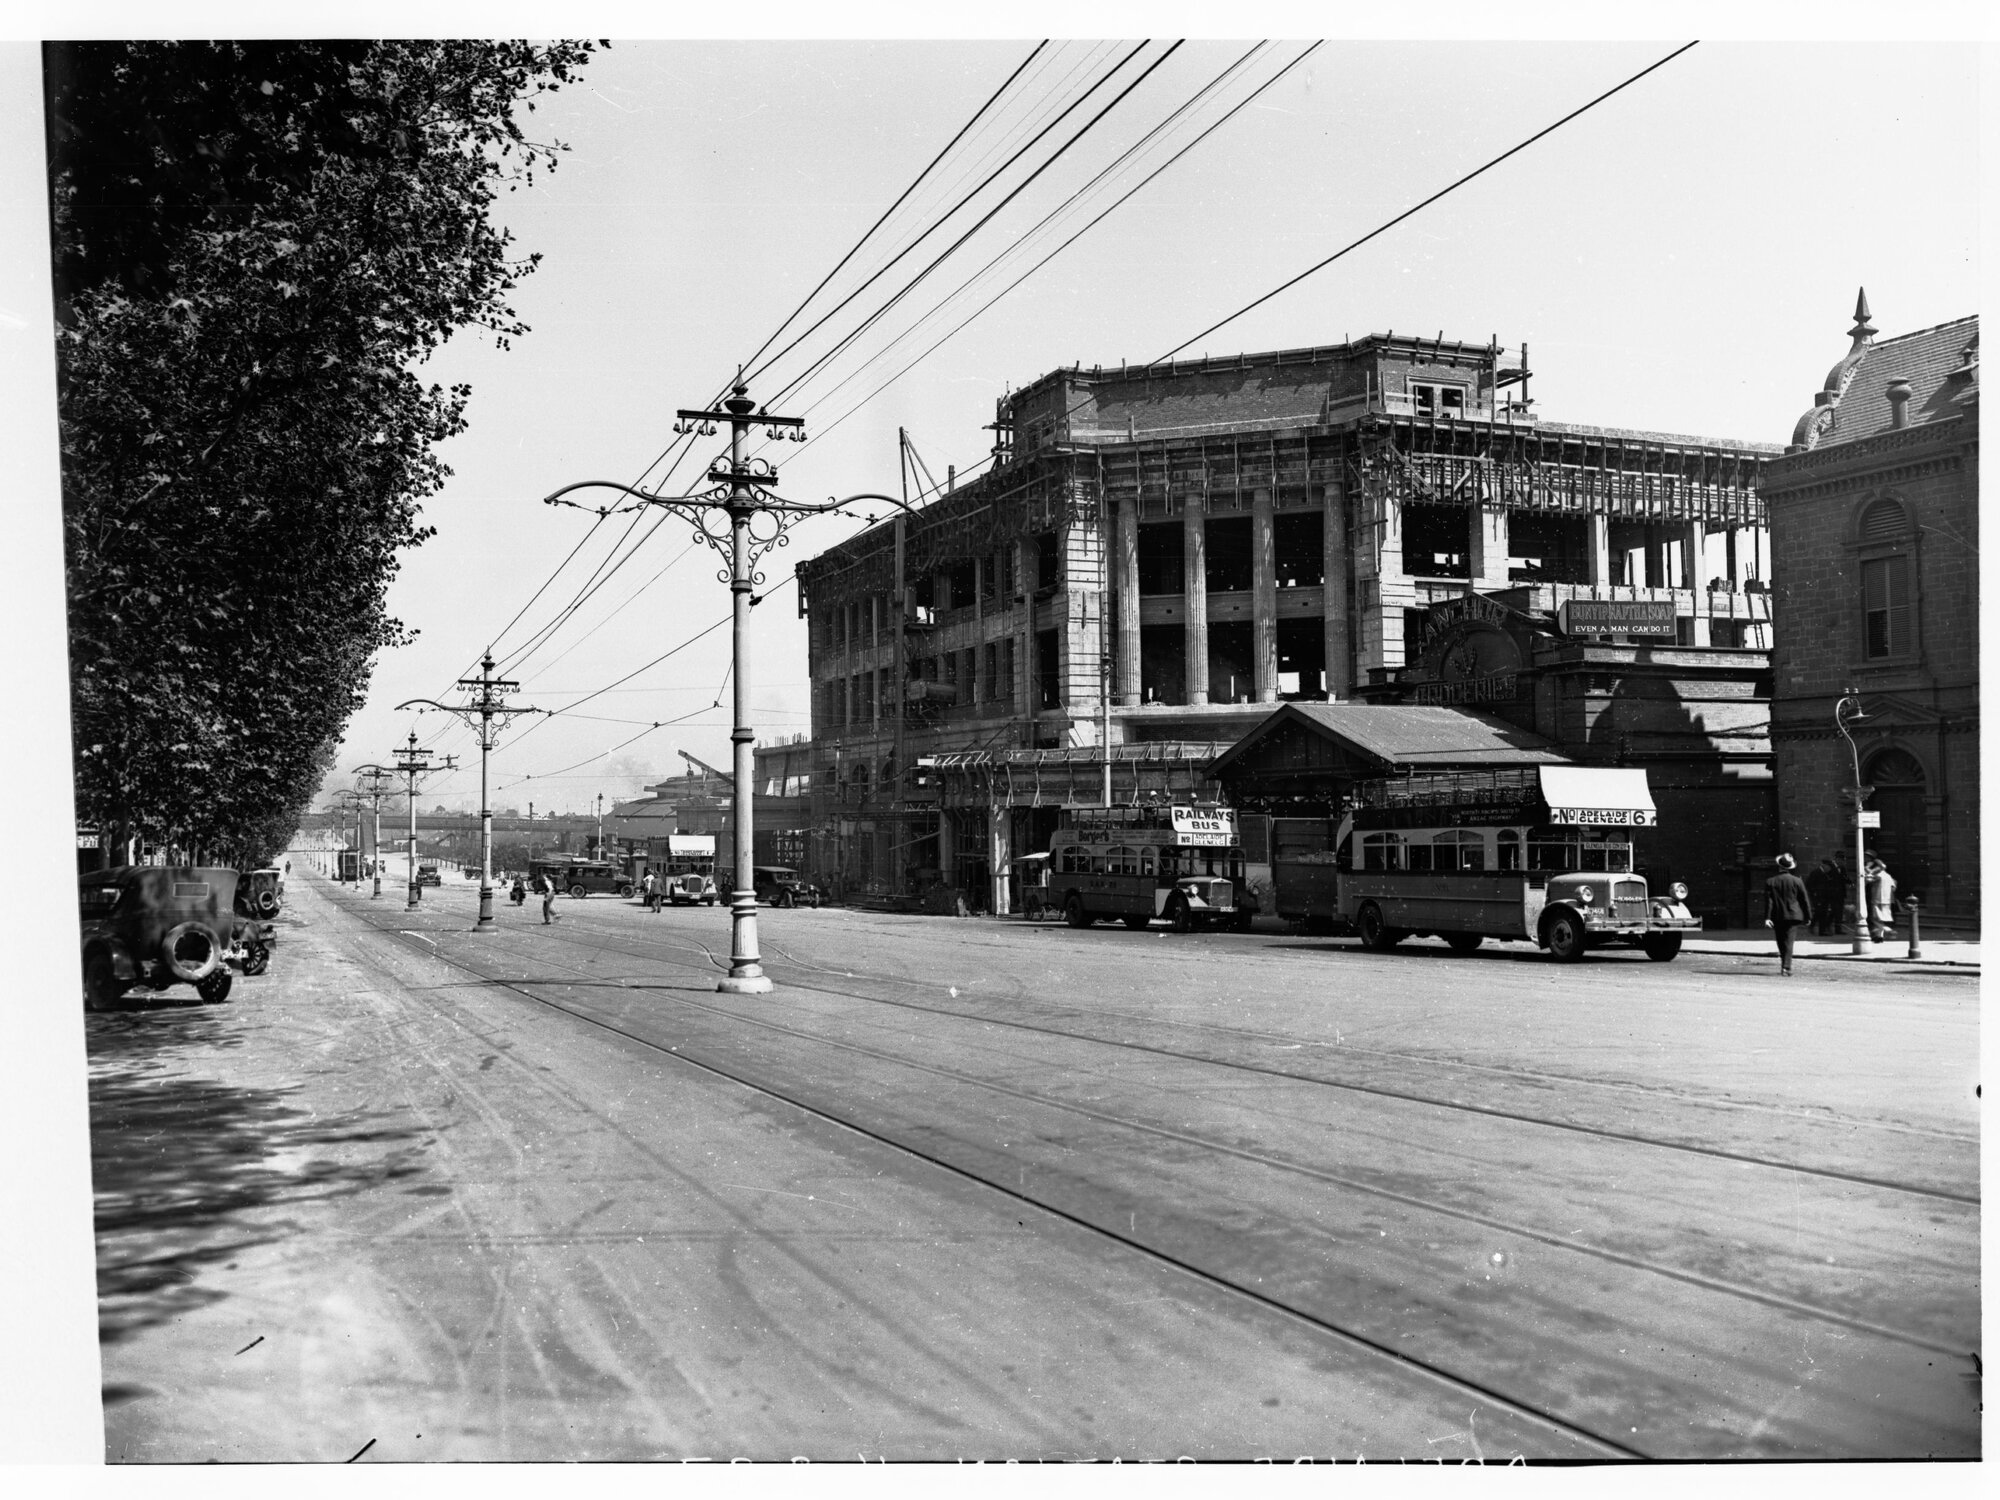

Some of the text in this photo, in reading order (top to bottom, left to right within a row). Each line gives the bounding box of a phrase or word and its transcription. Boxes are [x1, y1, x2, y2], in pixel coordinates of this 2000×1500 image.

[1570, 604, 1608, 620] BUNYIP
[1649, 604, 1674, 620] SOAP
[1424, 597, 1509, 646] ANCHOR
[1575, 625, 1670, 633] EVEN A MAN CAN DO IT
[1416, 674, 1517, 705] GROCERIES
[1174, 809, 1235, 823] RAILWAYS
[1579, 810, 1628, 818] ADELAIDE
[1633, 810, 1646, 825] 6
[1579, 816, 1628, 824] GLENELG
[1191, 821, 1220, 830] BUS
